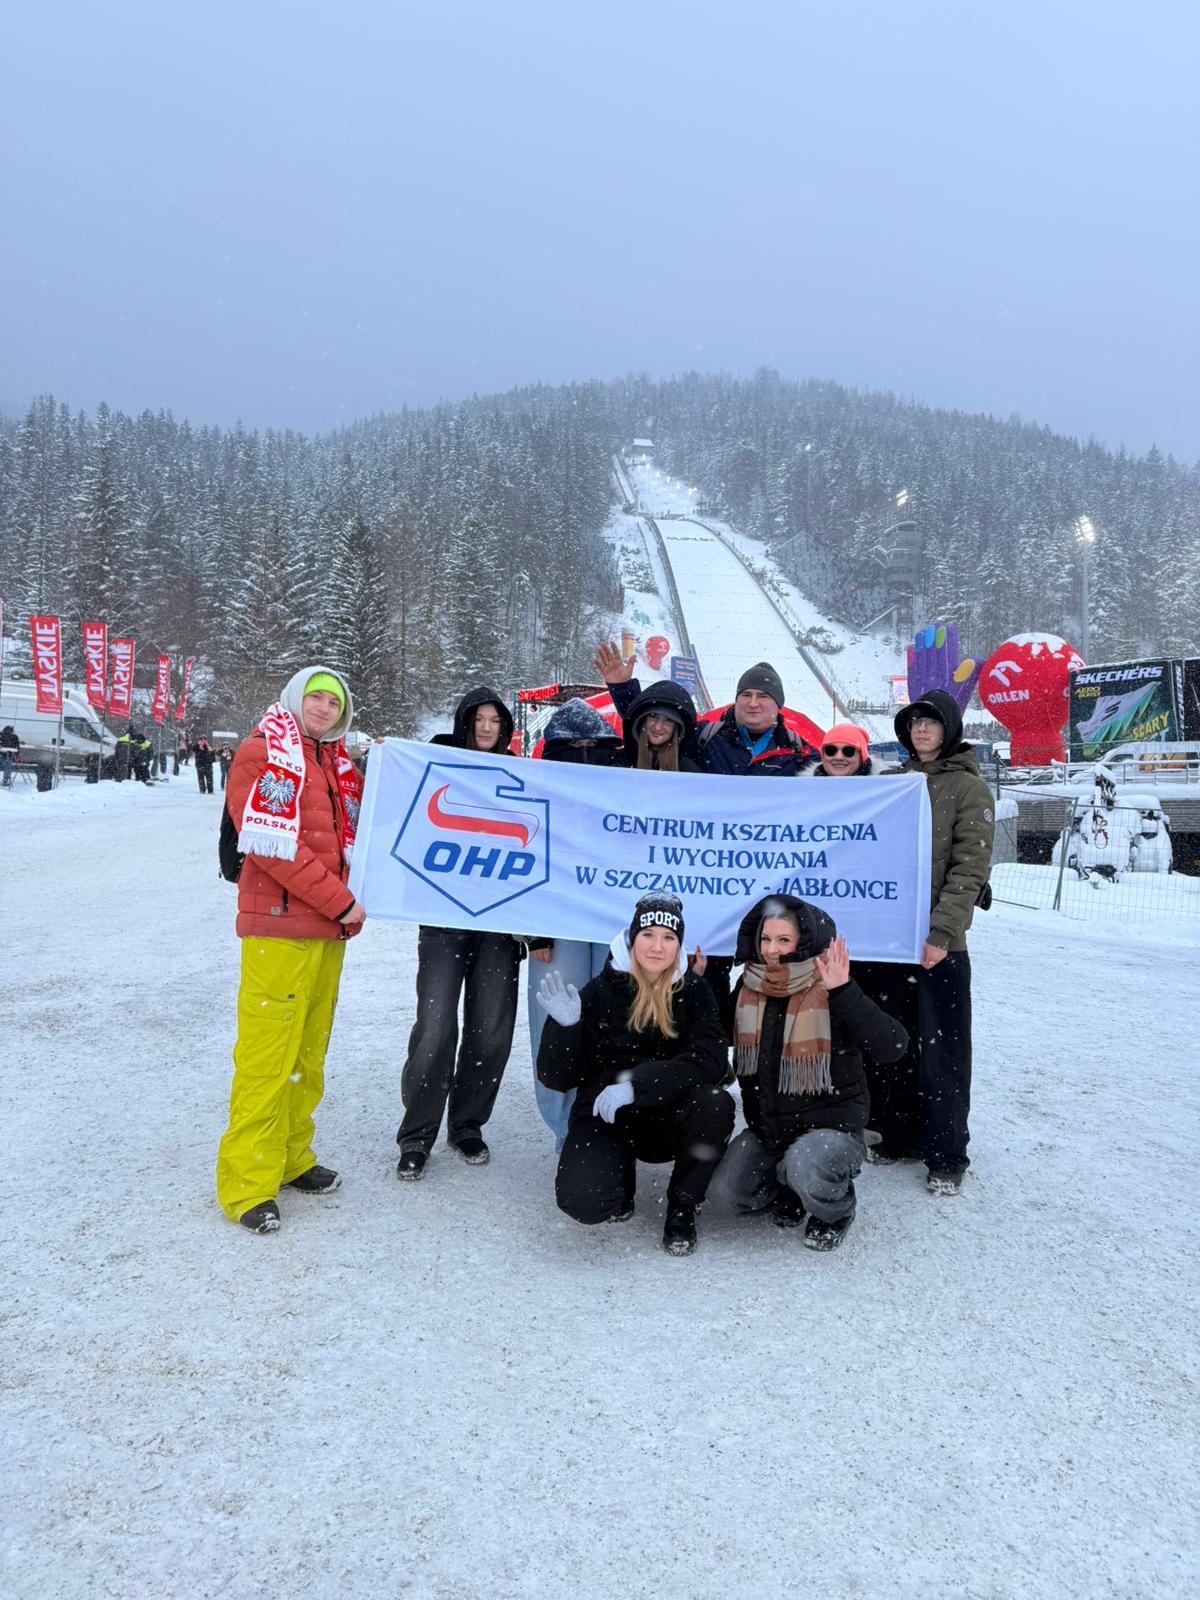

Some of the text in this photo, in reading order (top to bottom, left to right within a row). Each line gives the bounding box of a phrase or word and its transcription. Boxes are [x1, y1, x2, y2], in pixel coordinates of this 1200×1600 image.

[1075, 666, 1164, 685] SKECHERS
[988, 689, 1030, 704] ORLEN
[1132, 711, 1169, 740] SCARY
[270, 754, 303, 772] YLKO
[246, 815, 297, 832] POLSKA
[602, 813, 878, 843] CENTRUM KSZTAŁCENIA
[423, 841, 536, 880] OHP
[648, 845, 828, 869] I WYCHOWANIA
[575, 865, 598, 885] W
[603, 869, 756, 896] SZCZAWNICY
[776, 877, 898, 900] JABŁONCE
[640, 911, 680, 930] SPORT
